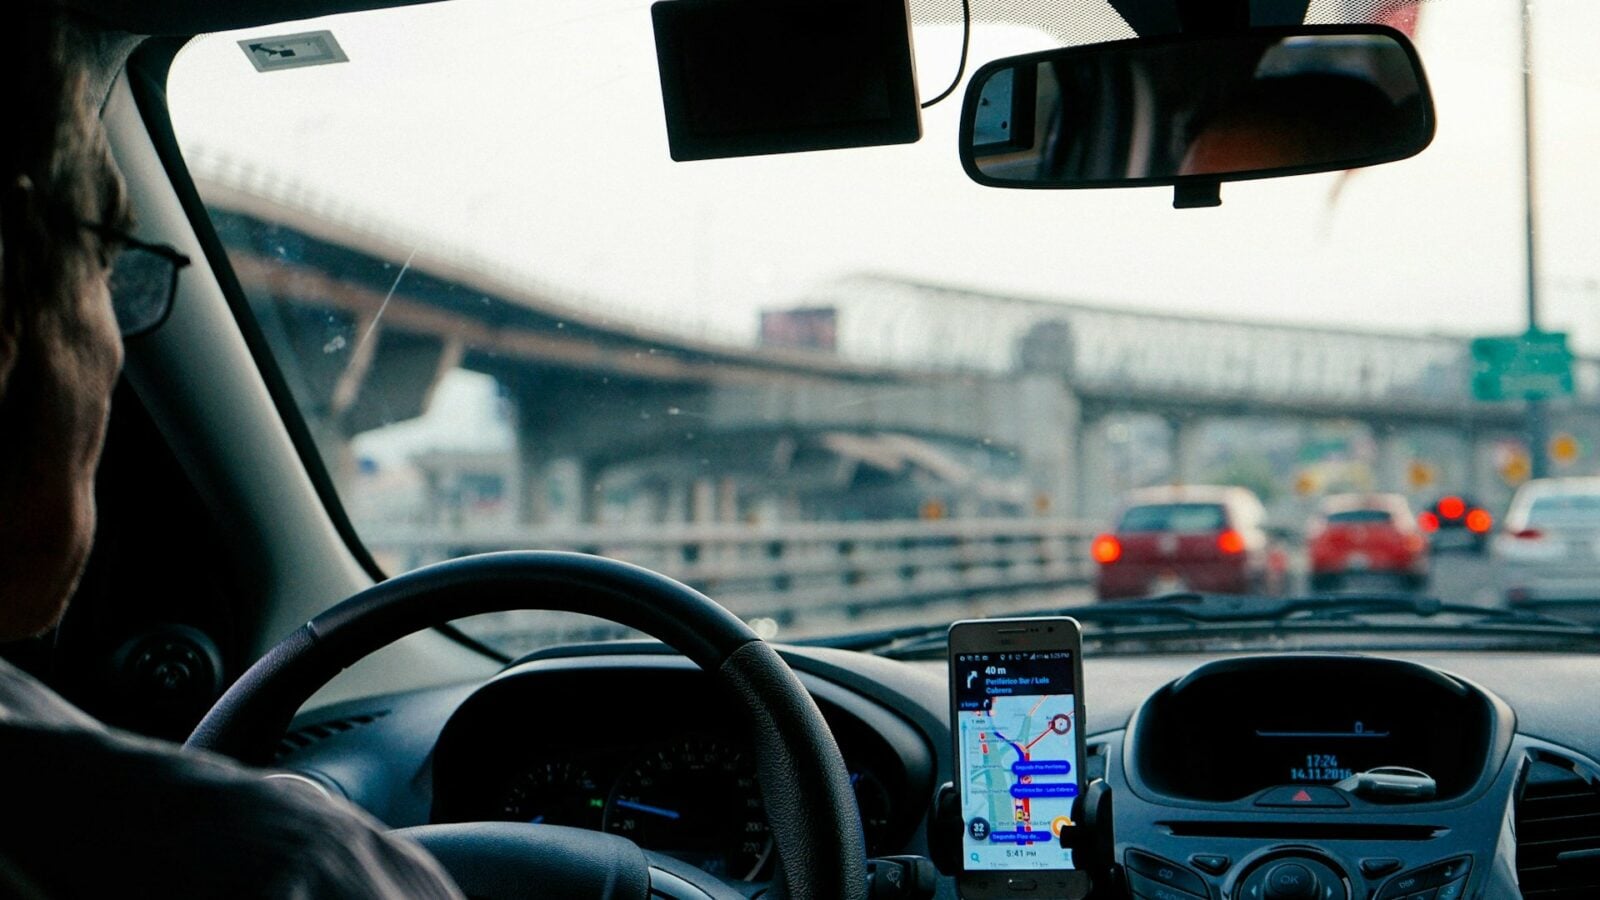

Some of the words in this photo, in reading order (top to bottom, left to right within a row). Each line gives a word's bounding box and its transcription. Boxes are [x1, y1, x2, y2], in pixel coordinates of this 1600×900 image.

[985, 666, 996, 675] 40
[1306, 755, 1338, 767] 17:24
[973, 823, 985, 832] 32
[1006, 849, 1023, 858] 5:41
[1158, 868, 1174, 879] CD
[1280, 875, 1299, 885] OK
